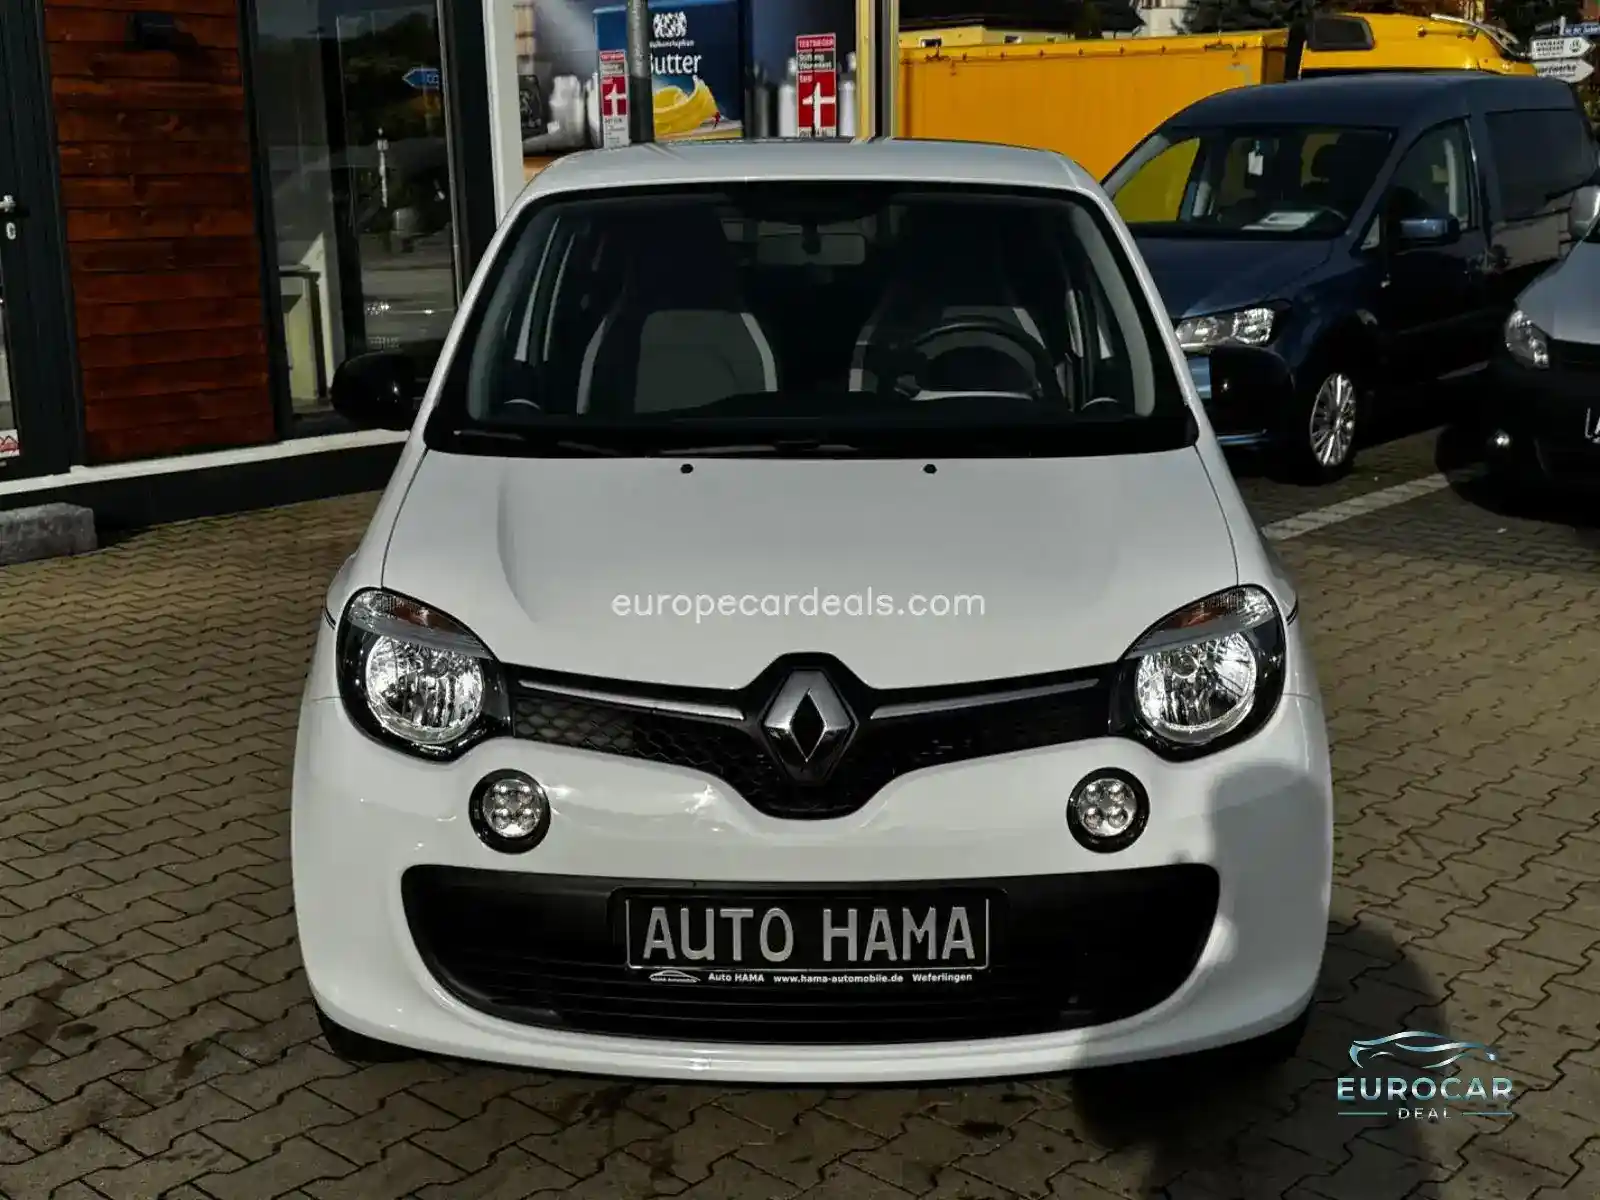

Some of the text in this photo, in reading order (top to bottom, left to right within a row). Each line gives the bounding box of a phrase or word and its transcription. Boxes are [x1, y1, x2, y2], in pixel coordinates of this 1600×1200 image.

[650, 53, 702, 74] utter
[643, 907, 976, 962] AUTO HAMA
[708, 972, 973, 983] Auto HAMA www.hama-automobile.de Weferlingen
